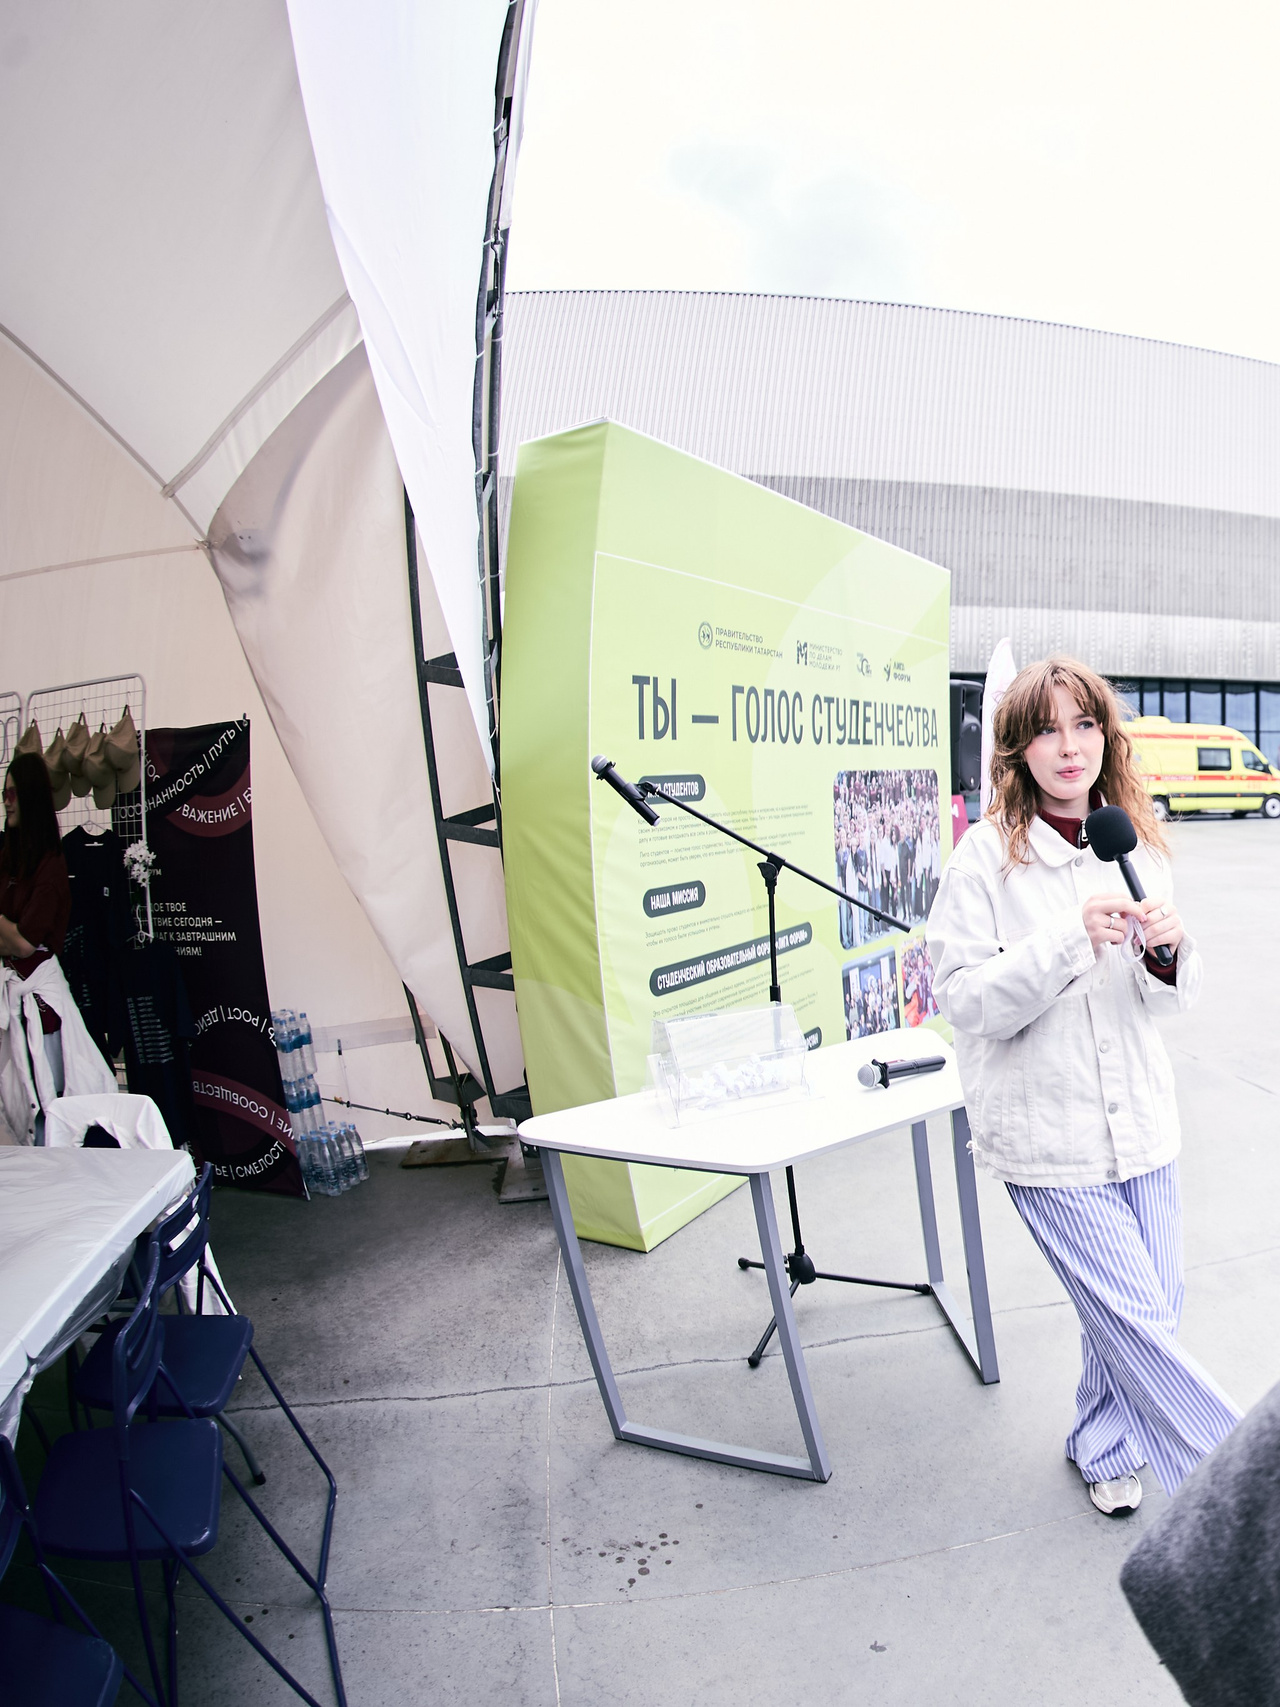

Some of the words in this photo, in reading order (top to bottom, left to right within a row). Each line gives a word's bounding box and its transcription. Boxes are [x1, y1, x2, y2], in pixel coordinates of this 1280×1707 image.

[715, 627, 763, 643] ПРАВИТЕЛЬСТВО
[715, 640, 753, 653] РЕСПУБЛИКИ
[754, 646, 783, 658] ТАТАРСТАН
[632, 674, 677, 740] ТЫ
[731, 684, 803, 745] ГОЛОС
[811, 693, 939, 748] СТУДЕНЧЕСТВА
[208, 728, 236, 761] ПУТЬ
[663, 781, 699, 797] СТУДЕНТОВ
[176, 803, 239, 824] ВАЖЕНИЕ
[165, 902, 187, 912] ТВОЕ
[650, 894, 671, 910] НАША
[671, 886, 699, 906] МИССИЯ
[173, 917, 213, 928] СЕГОДНЯ
[176, 931, 237, 942] ЗАВТРАШНИМ
[657, 960, 705, 990] СТУДЕНЧЕСКИЙ
[706, 943, 756, 975] ОБРАЗОВАТЕЛЬНЫЙ
[756, 941, 770, 957] ФОРУ
[228, 1007, 259, 1027] РОСТ
[192, 1080, 268, 1118] СООБЩЕСТВ
